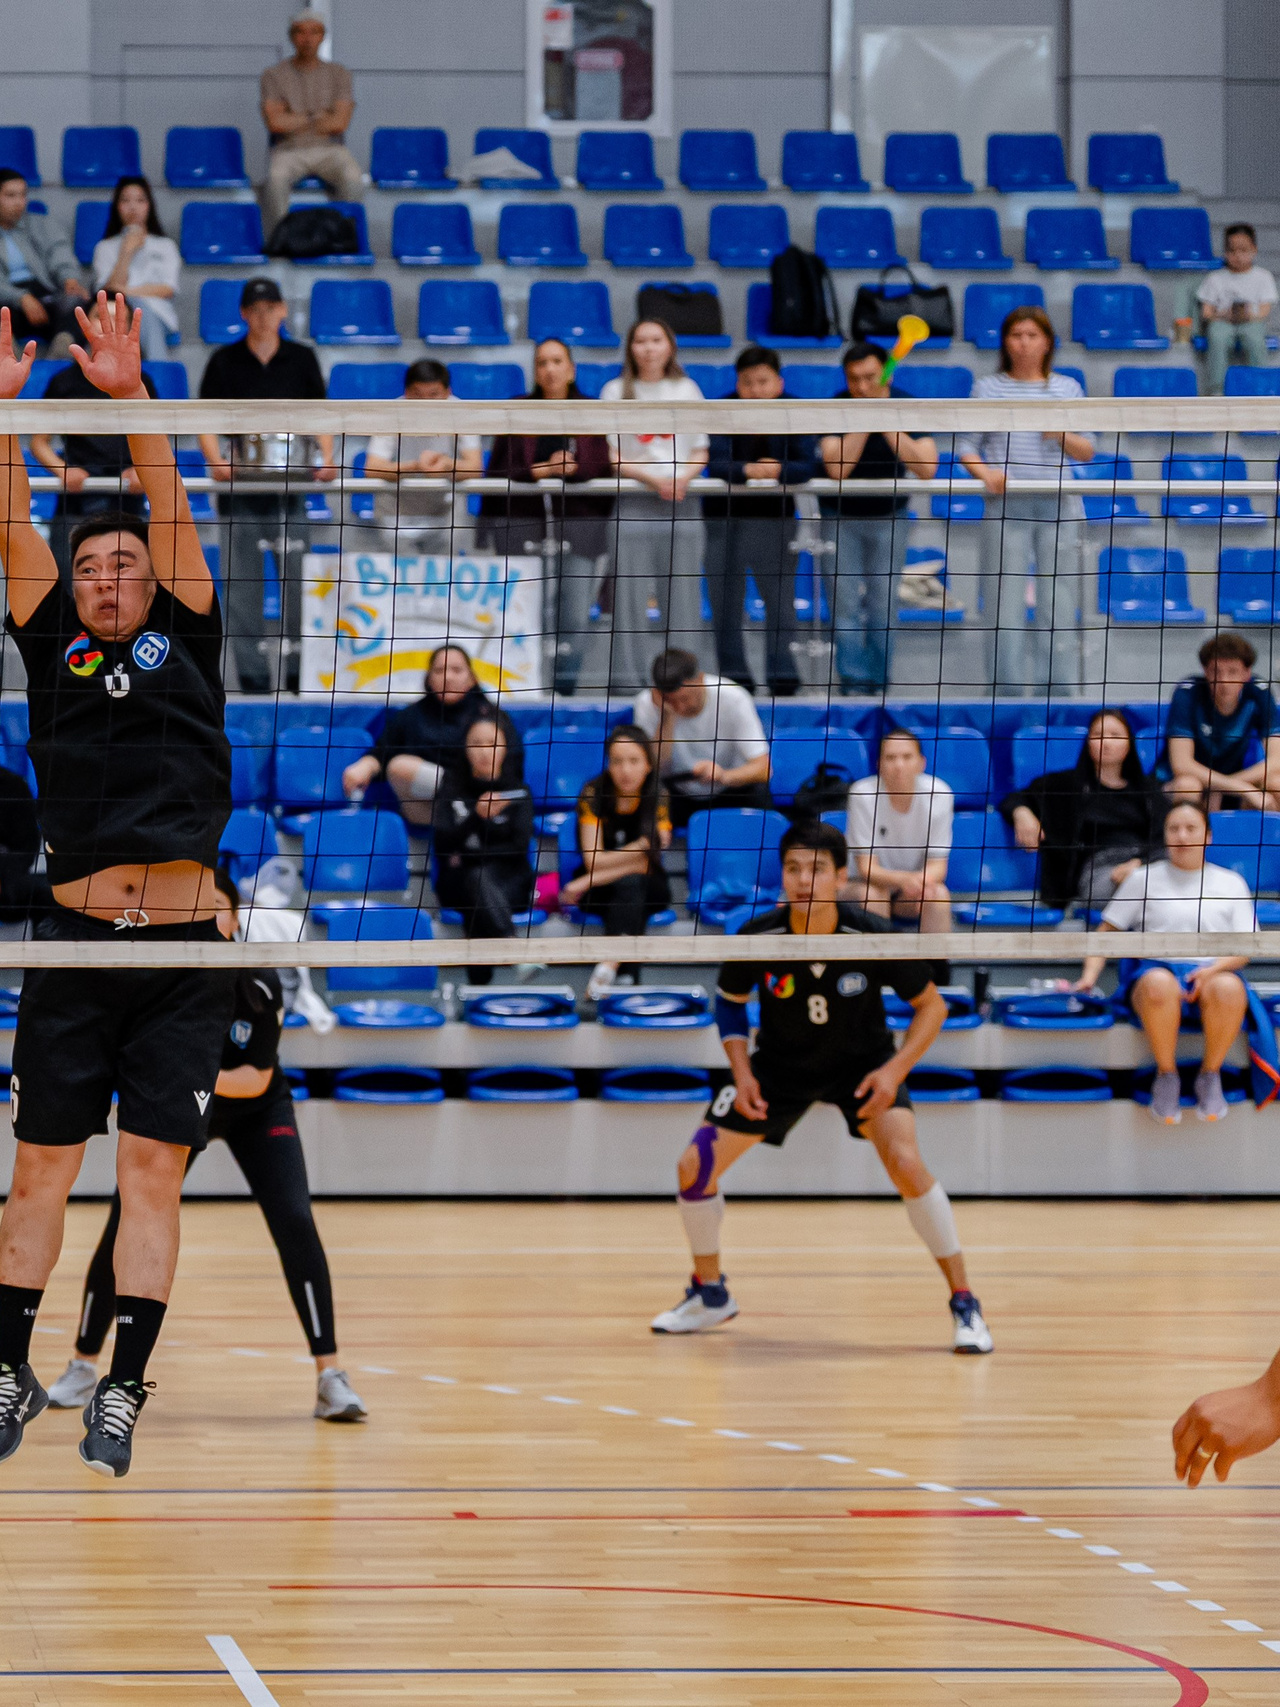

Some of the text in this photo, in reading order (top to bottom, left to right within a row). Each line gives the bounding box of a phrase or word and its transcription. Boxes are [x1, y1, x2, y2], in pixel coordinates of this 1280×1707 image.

[356, 556, 521, 611] BINOM
[136, 636, 166, 666] BI
[807, 994, 829, 1025] 8
[711, 1085, 737, 1117] 8
